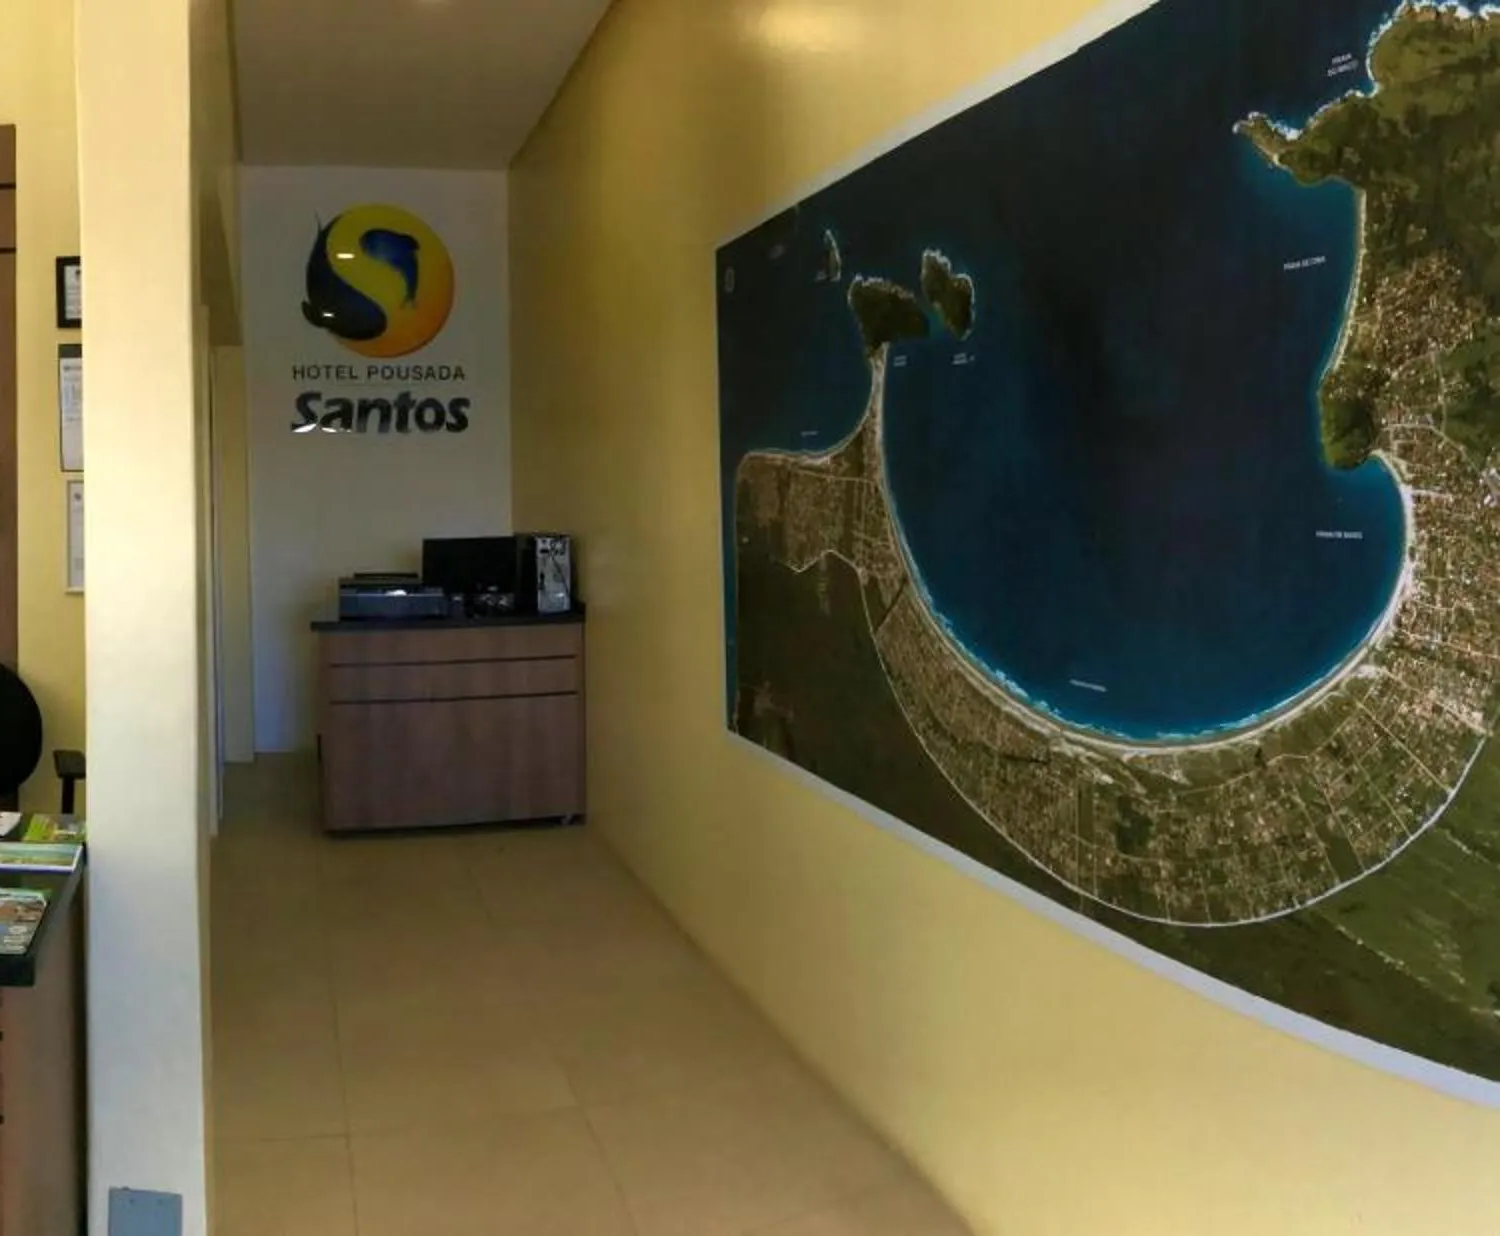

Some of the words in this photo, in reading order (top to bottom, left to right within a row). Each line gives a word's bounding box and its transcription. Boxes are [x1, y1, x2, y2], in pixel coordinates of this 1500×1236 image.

[292, 364, 358, 381] HOTEL
[367, 364, 465, 381] POUSADA
[291, 390, 471, 433] Santos
